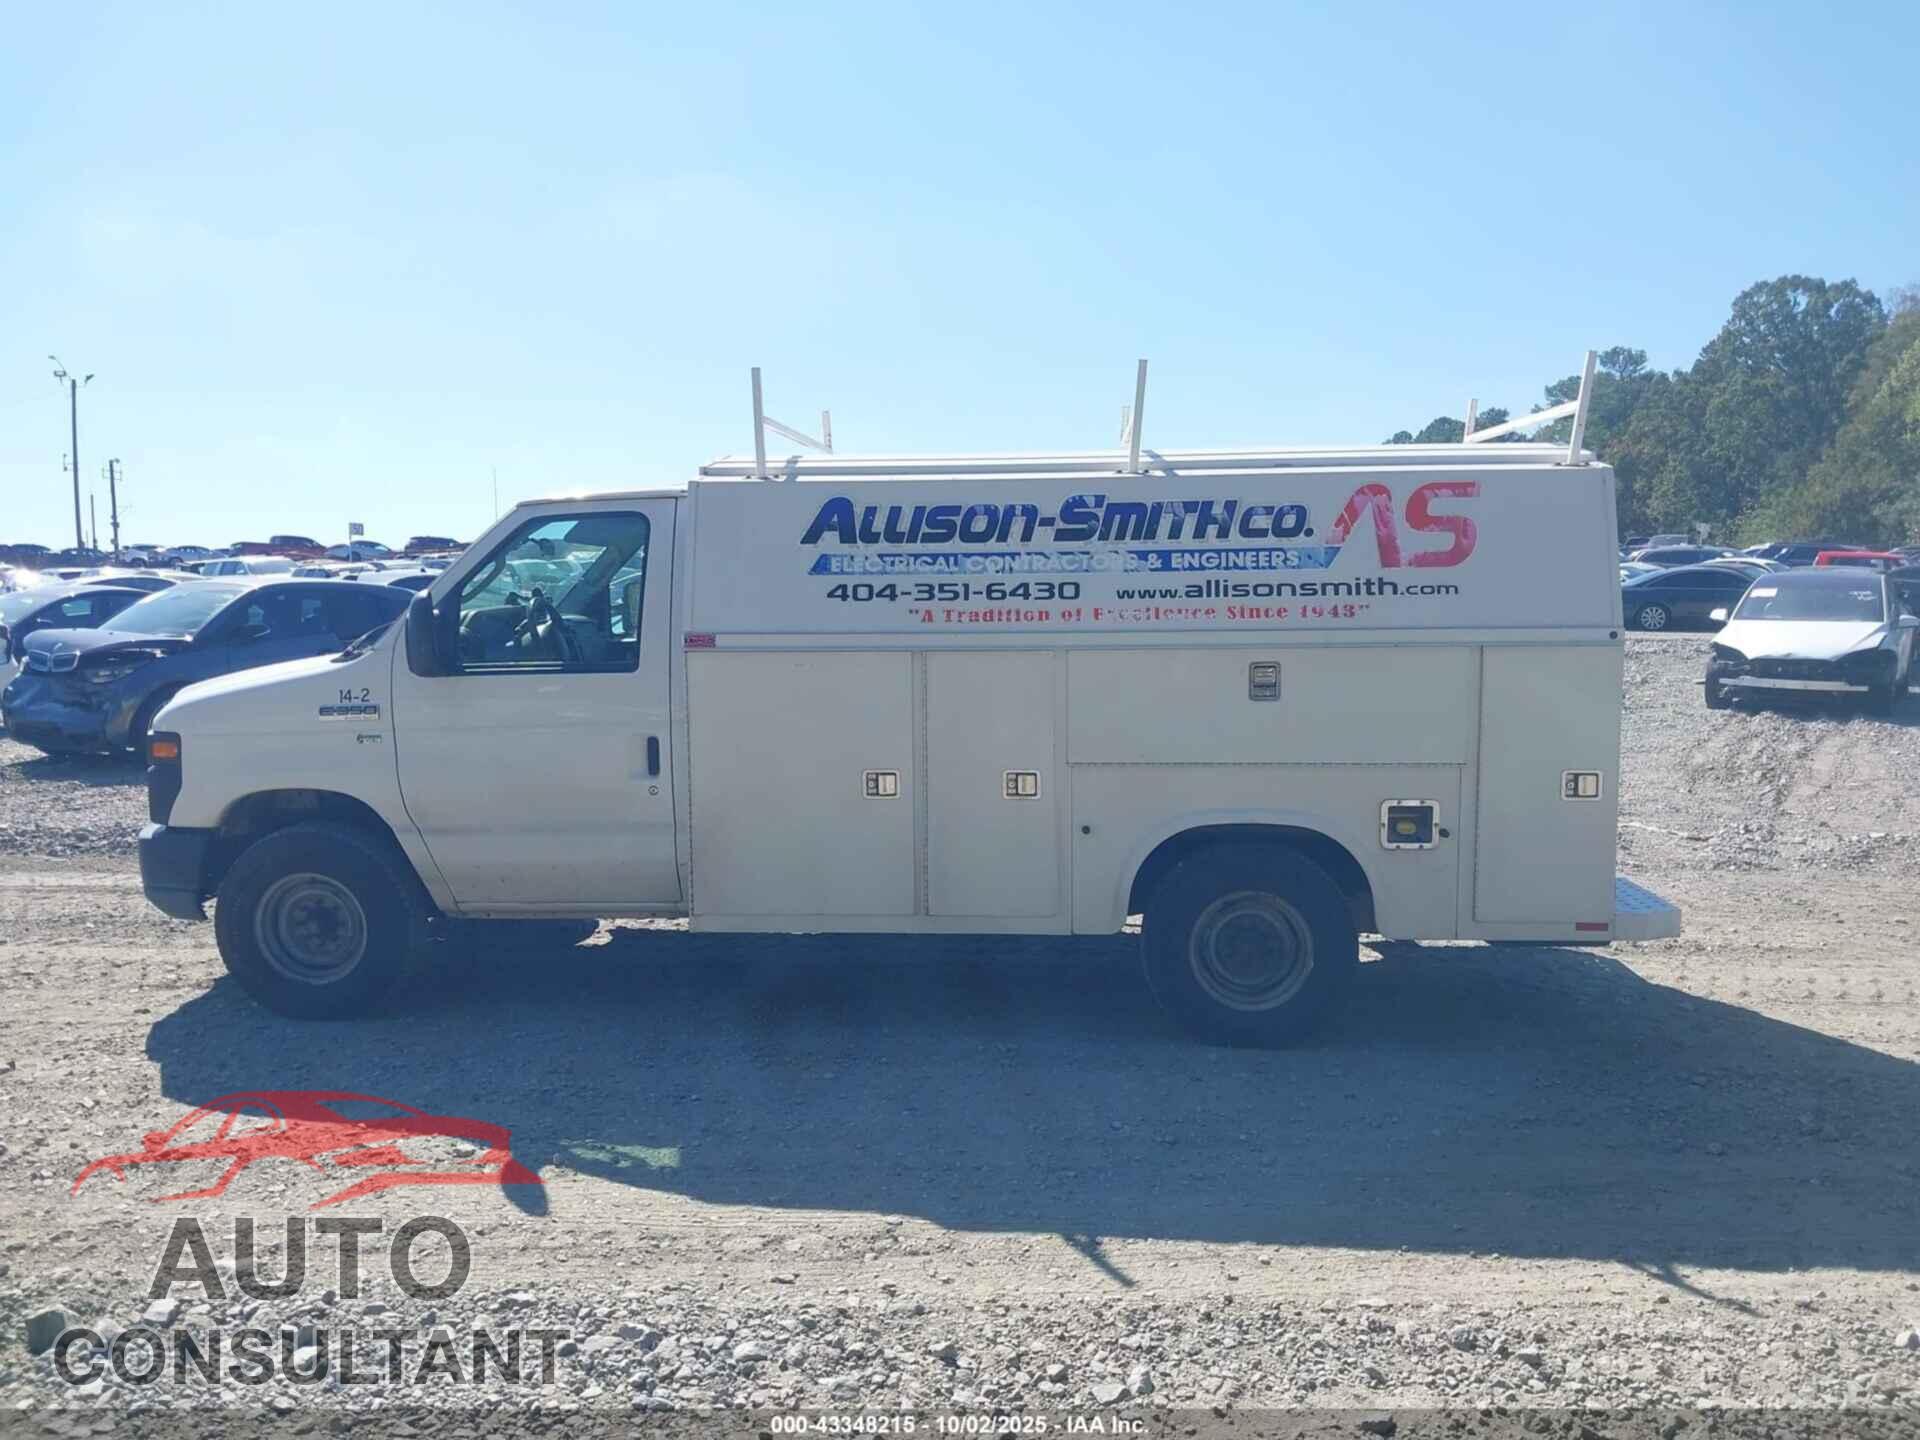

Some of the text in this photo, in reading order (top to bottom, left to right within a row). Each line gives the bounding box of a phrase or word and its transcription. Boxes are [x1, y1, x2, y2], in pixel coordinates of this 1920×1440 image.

[1147, 552, 1162, 569] &
[1171, 551, 1300, 570] ENGINEERS
[827, 582, 1081, 601] 404-351-6430
[1116, 578, 1459, 600] www.allisonsmith.com
[943, 608, 1050, 623] Tradition
[1061, 608, 1082, 622] of
[1226, 603, 1289, 620] Since
[339, 687, 370, 703] 14-2
